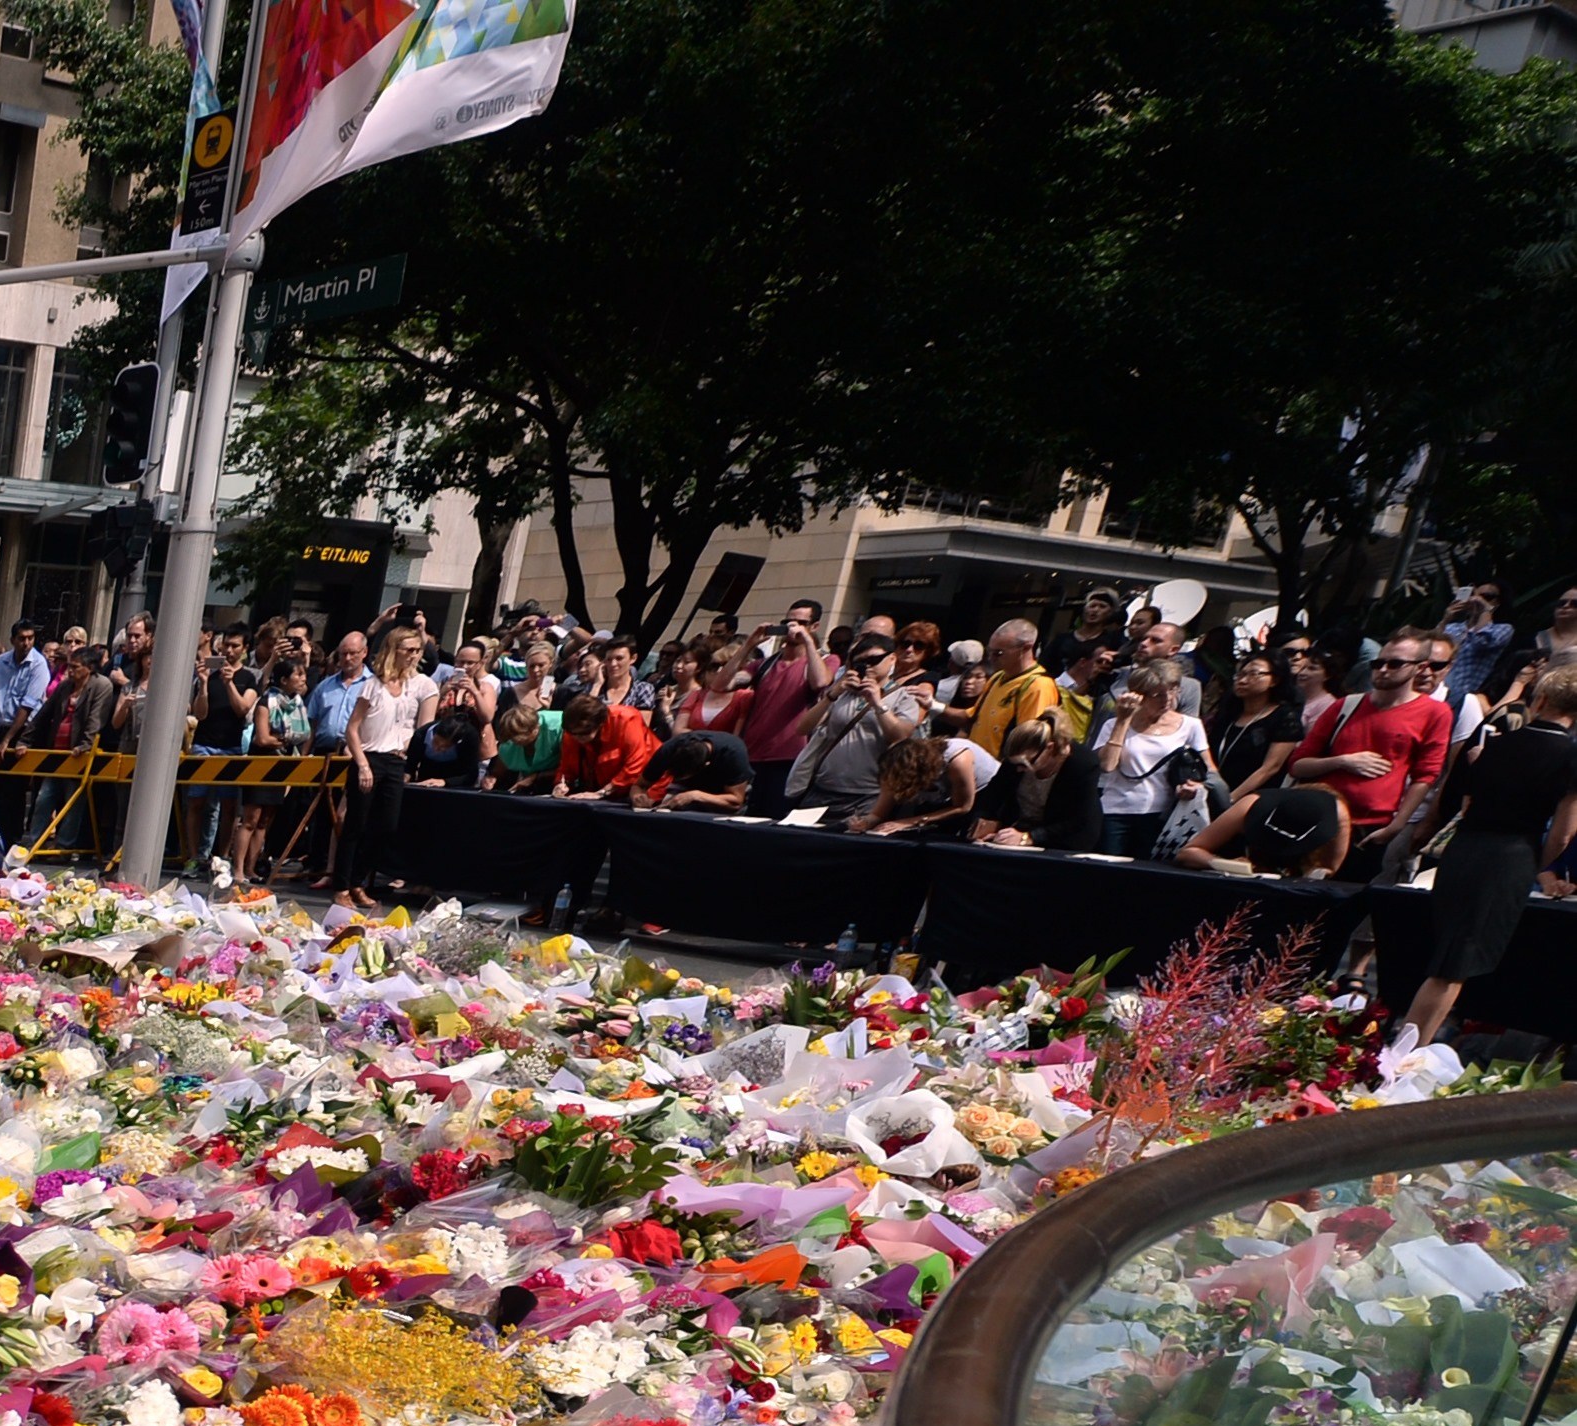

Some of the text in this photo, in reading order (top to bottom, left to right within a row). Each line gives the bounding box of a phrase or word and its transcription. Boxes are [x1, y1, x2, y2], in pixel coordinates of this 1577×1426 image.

[188, 178, 210, 190] Martin
[194, 186, 219, 198] Station
[283, 266, 377, 307] Martin Pl
[303, 545, 371, 564] BEITLING
